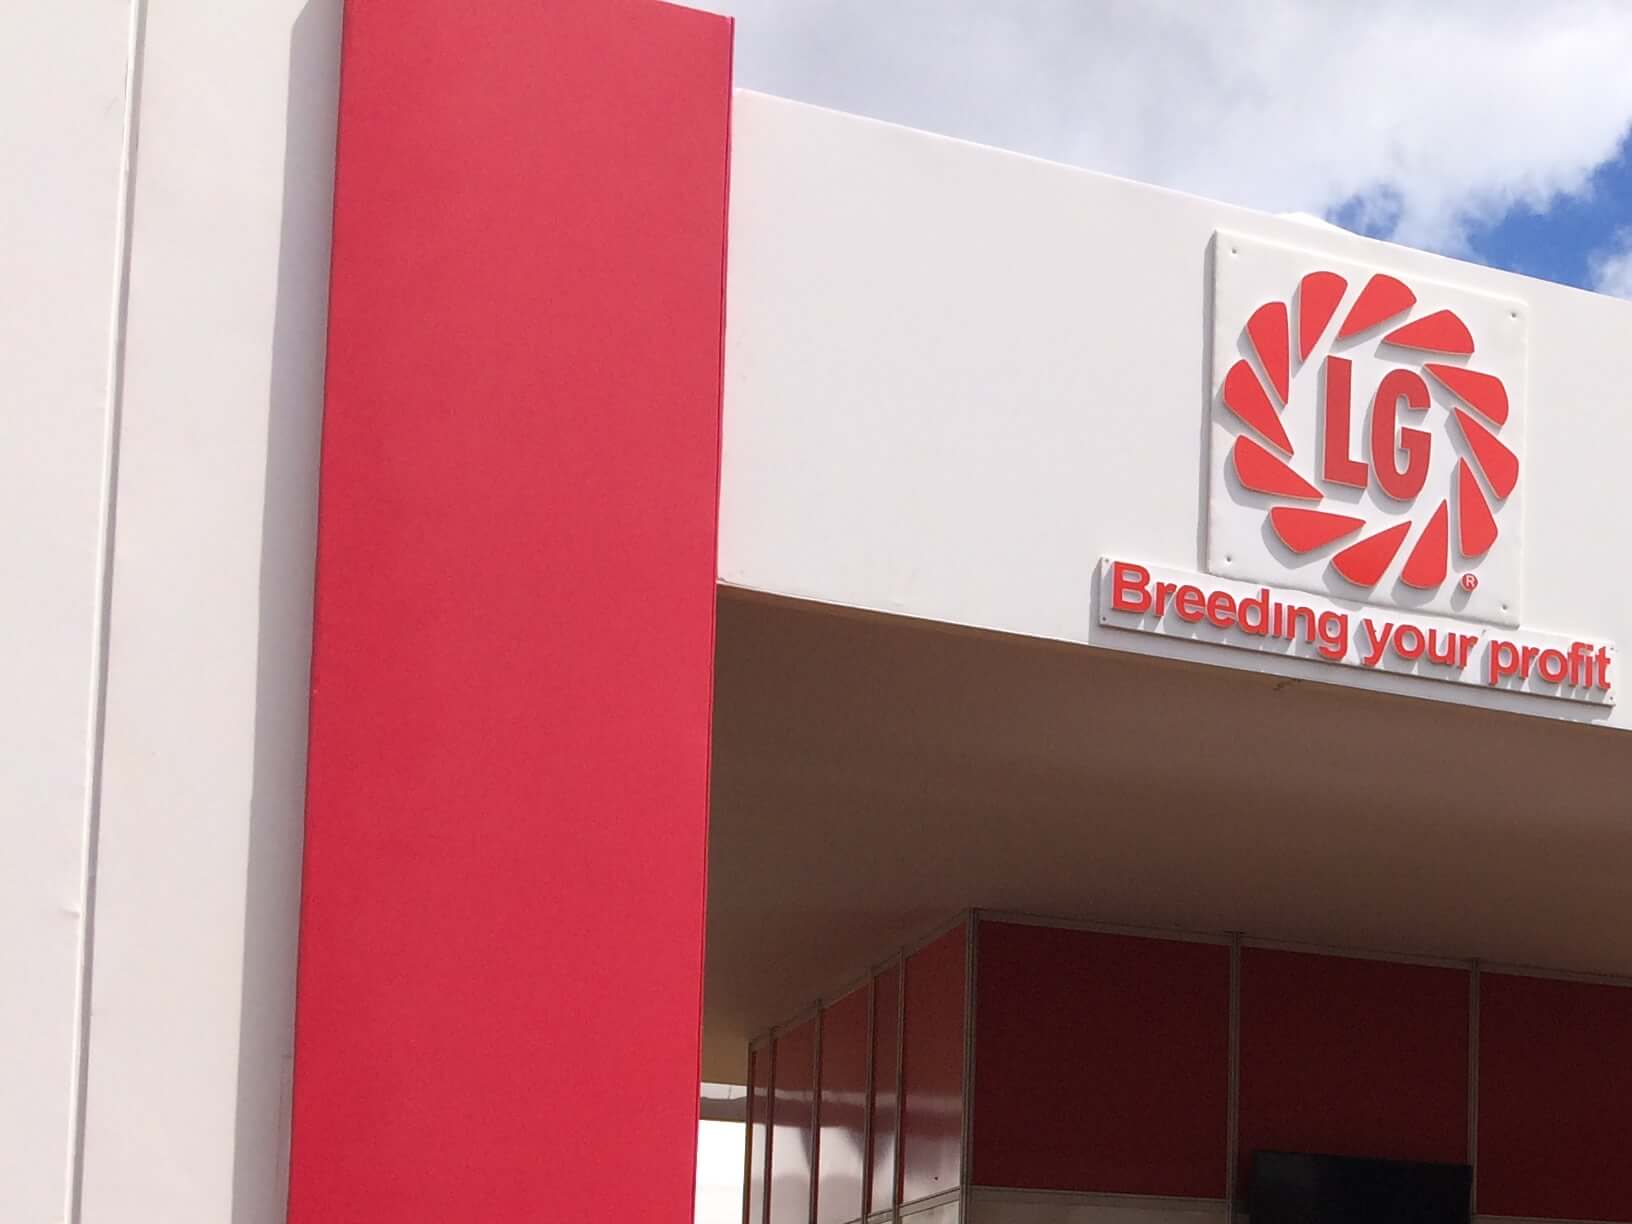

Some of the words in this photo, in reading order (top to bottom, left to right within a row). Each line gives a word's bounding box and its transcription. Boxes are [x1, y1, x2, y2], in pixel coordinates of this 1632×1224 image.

[1322, 355, 1431, 502] LG
[1110, 560, 1349, 660] Breeding
[1363, 616, 1478, 671] your
[1489, 640, 1613, 691] profit
